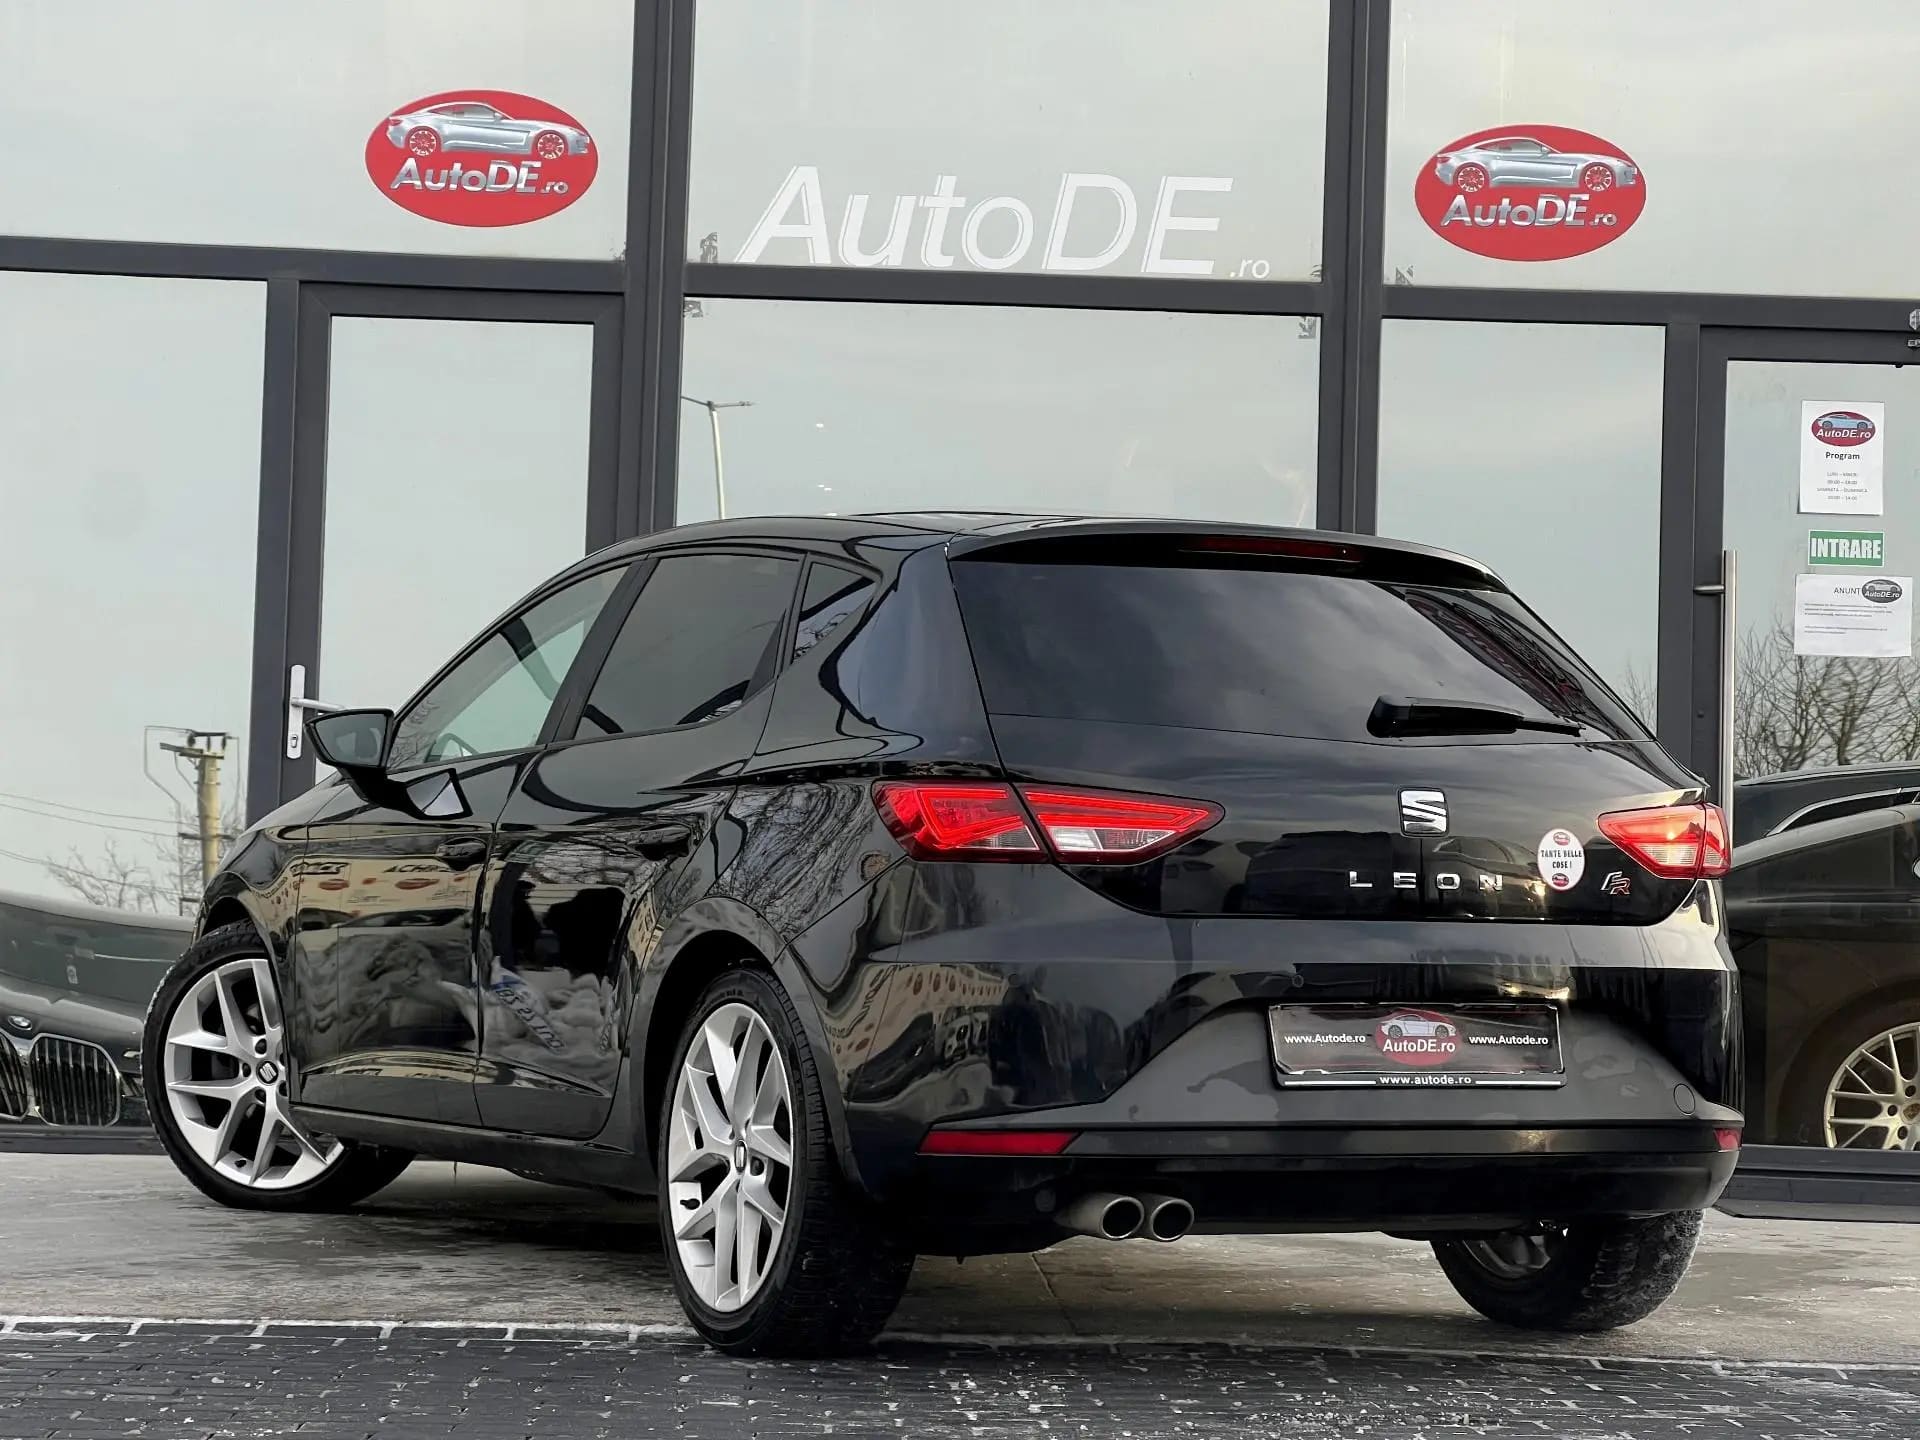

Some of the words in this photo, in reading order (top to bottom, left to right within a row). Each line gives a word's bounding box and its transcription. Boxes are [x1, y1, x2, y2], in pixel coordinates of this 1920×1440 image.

[1816, 429, 1872, 439] AutoDE.ro
[1825, 451, 1860, 461] Program
[1810, 537, 1882, 559] INTRARE
[1864, 590, 1900, 598] AutoDE.ro
[1541, 849, 1562, 858] TANTE
[1349, 870, 1503, 891] LEON
[1284, 1033, 1367, 1044] www.Autode.ro
[1468, 1034, 1549, 1046] www.Autode.ro
[1382, 1038, 1456, 1054] AutoDE.ro
[1379, 1074, 1472, 1086] www.autode.ro
